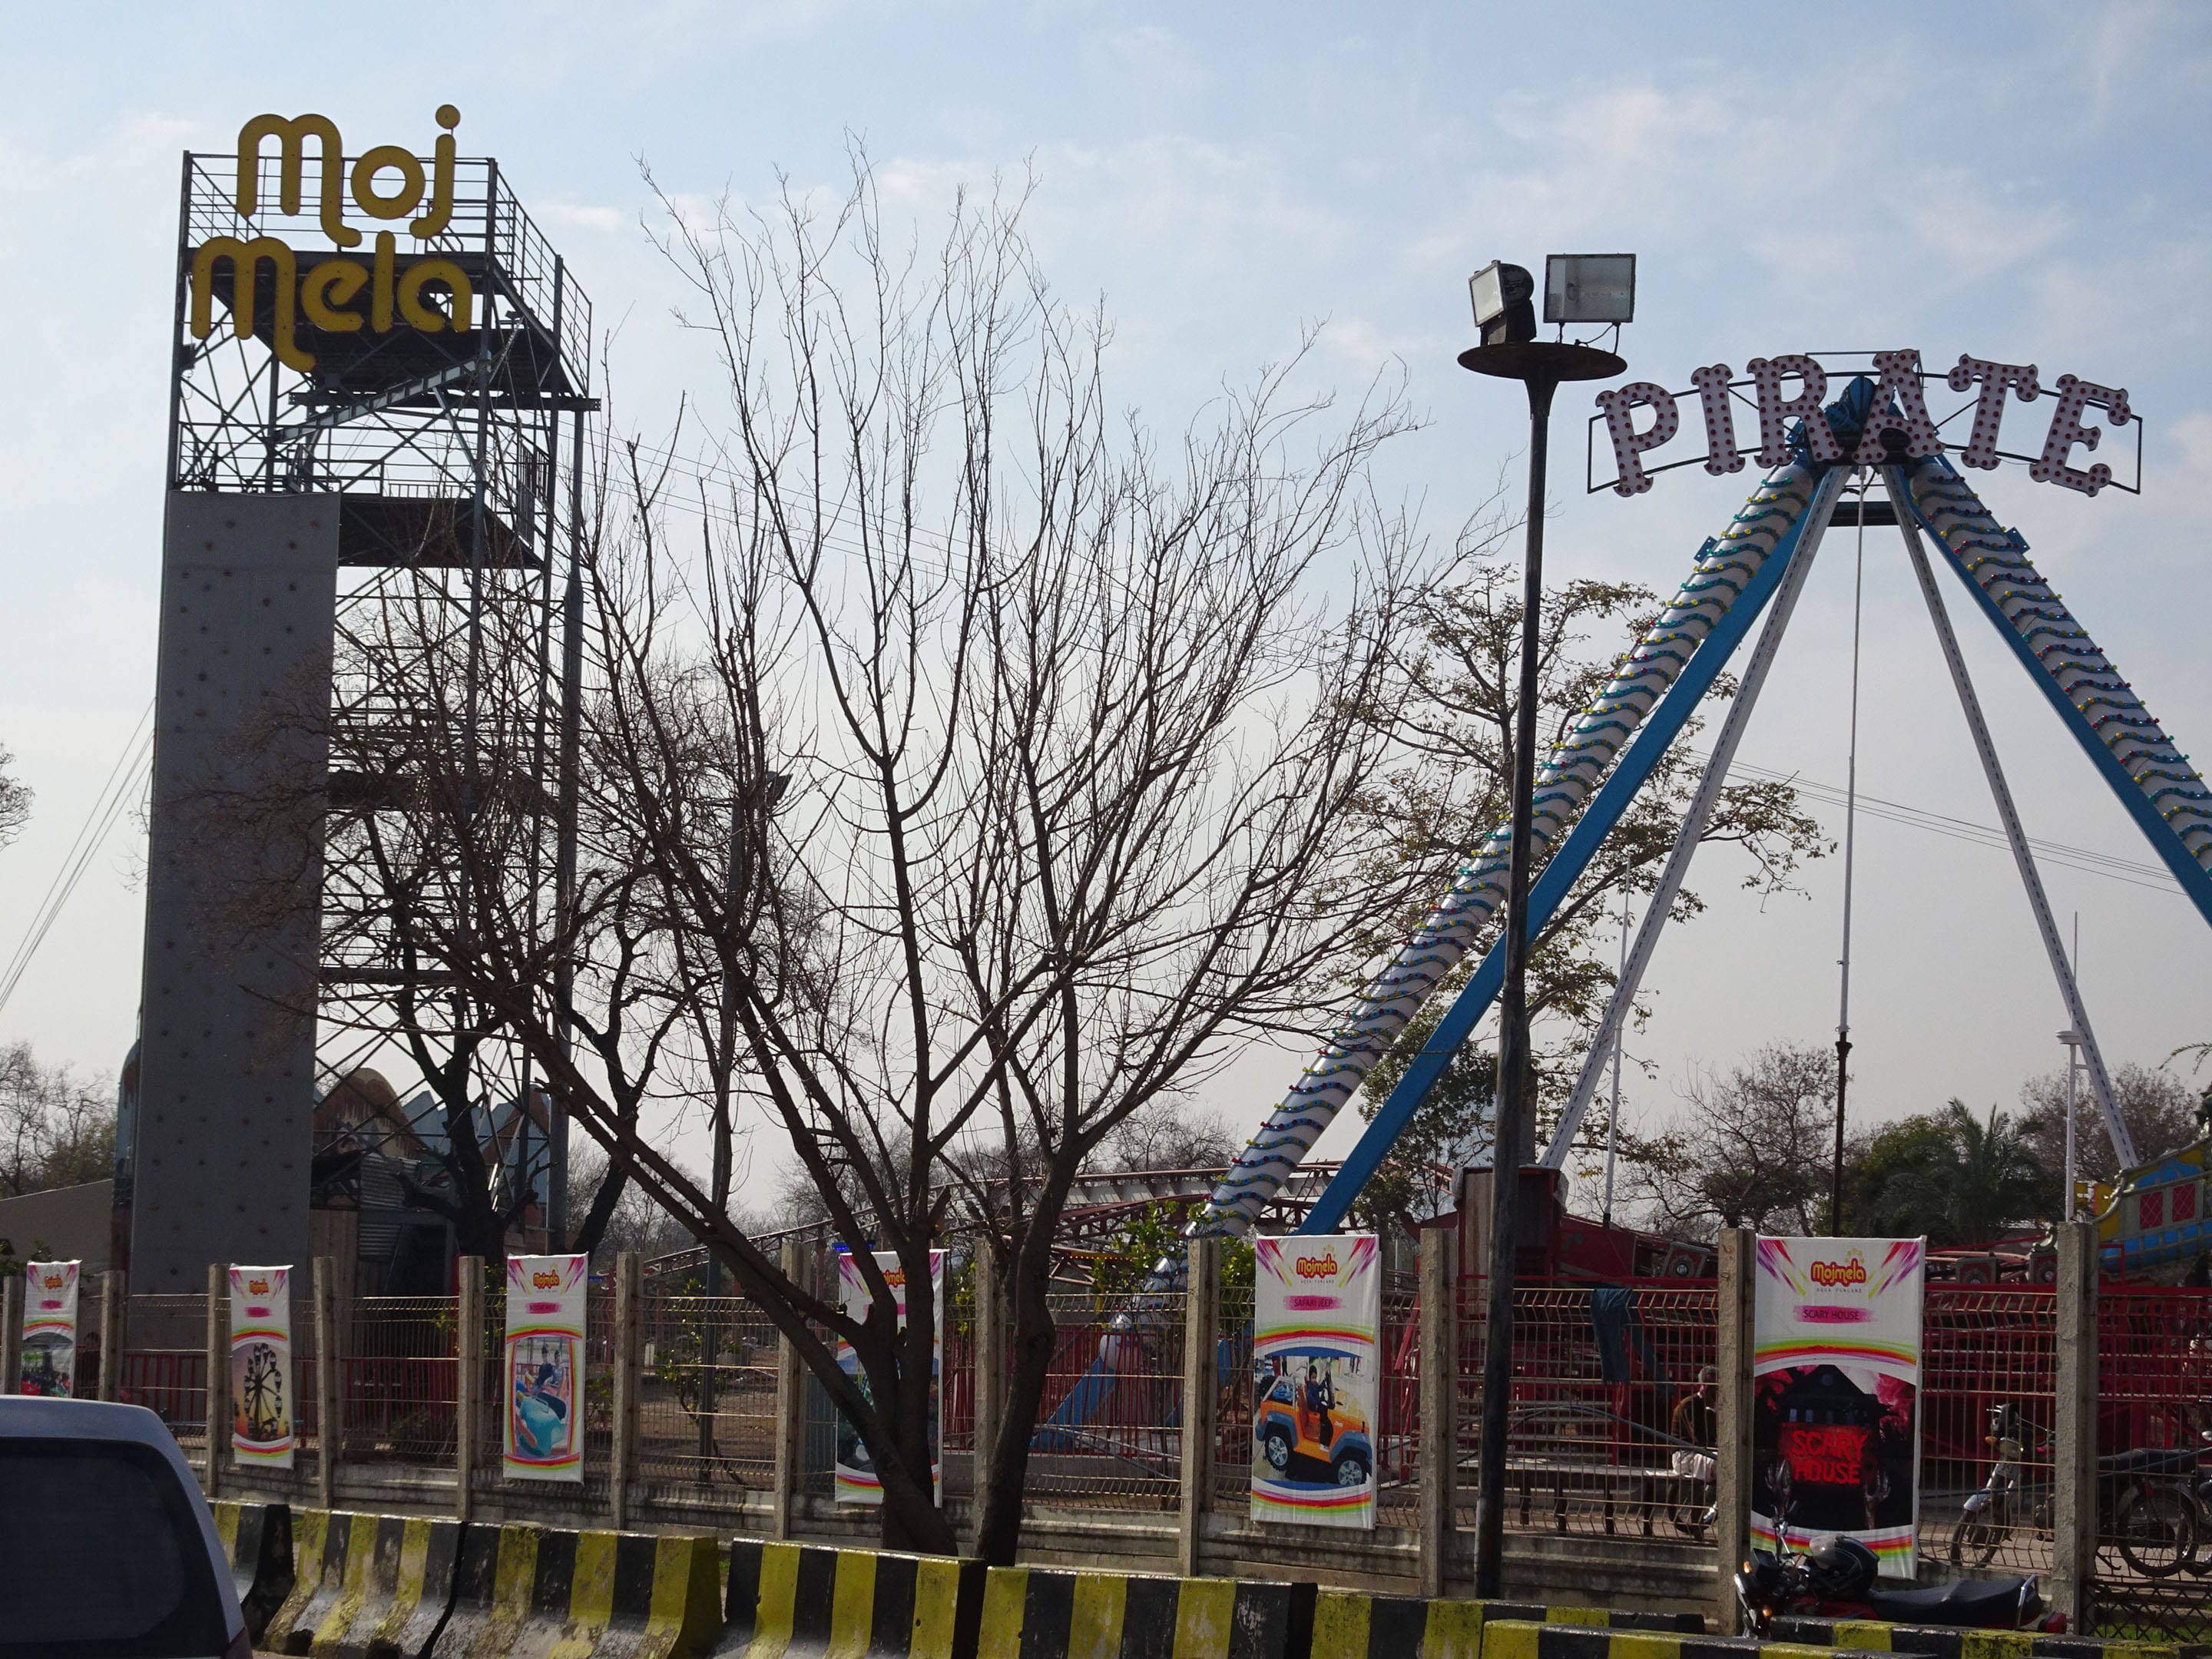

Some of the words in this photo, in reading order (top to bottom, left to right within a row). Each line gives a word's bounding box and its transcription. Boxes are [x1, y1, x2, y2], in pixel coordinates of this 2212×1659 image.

[1595, 349, 2131, 498] PIRATE
[1294, 1298, 1316, 1307] SAFARI
[1318, 1298, 1333, 1307] JEEP
[1803, 1309, 1830, 1319] SCARY
[1831, 1310, 1859, 1320] HOUSE
[1791, 1429, 1868, 1461] SCARY
[1793, 1460, 1860, 1485] HOUSE
